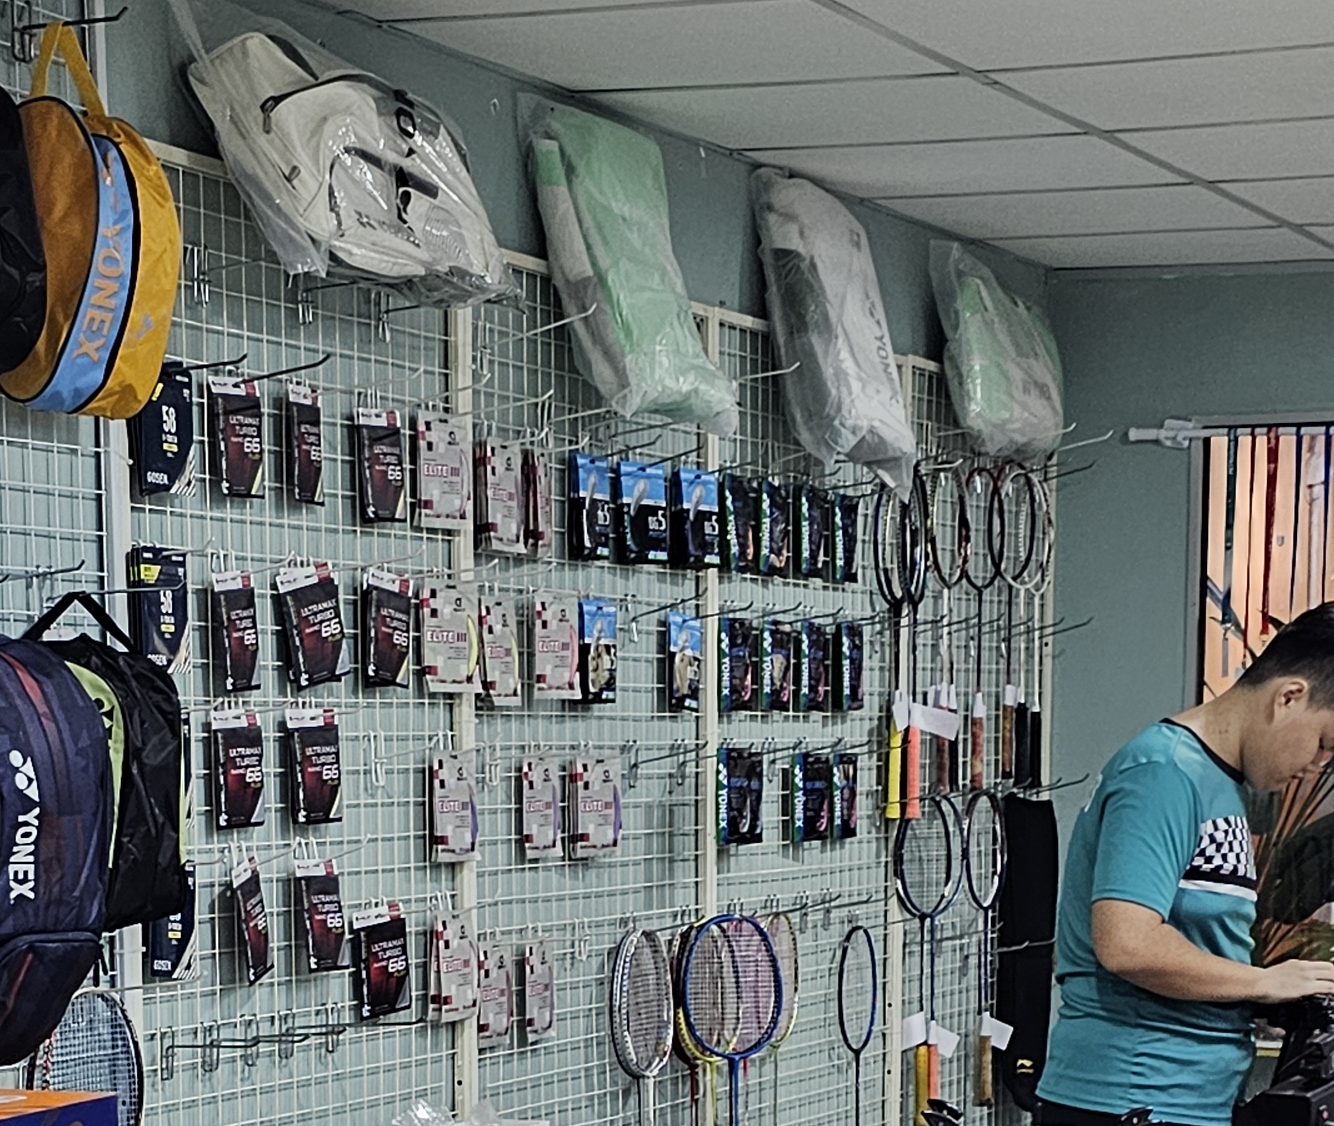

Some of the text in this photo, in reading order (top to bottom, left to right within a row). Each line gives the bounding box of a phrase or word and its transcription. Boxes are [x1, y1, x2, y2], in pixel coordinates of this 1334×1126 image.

[72, 224, 123, 363] YONEX
[162, 405, 177, 433] 58
[244, 437, 261, 453] 66
[423, 463, 449, 478] ELITE
[300, 598, 337, 617] ULTRAMAX
[321, 618, 341, 637] 66
[426, 630, 455, 644] ELITE
[8, 807, 40, 901] YONEX
[388, 955, 407, 973] 66
